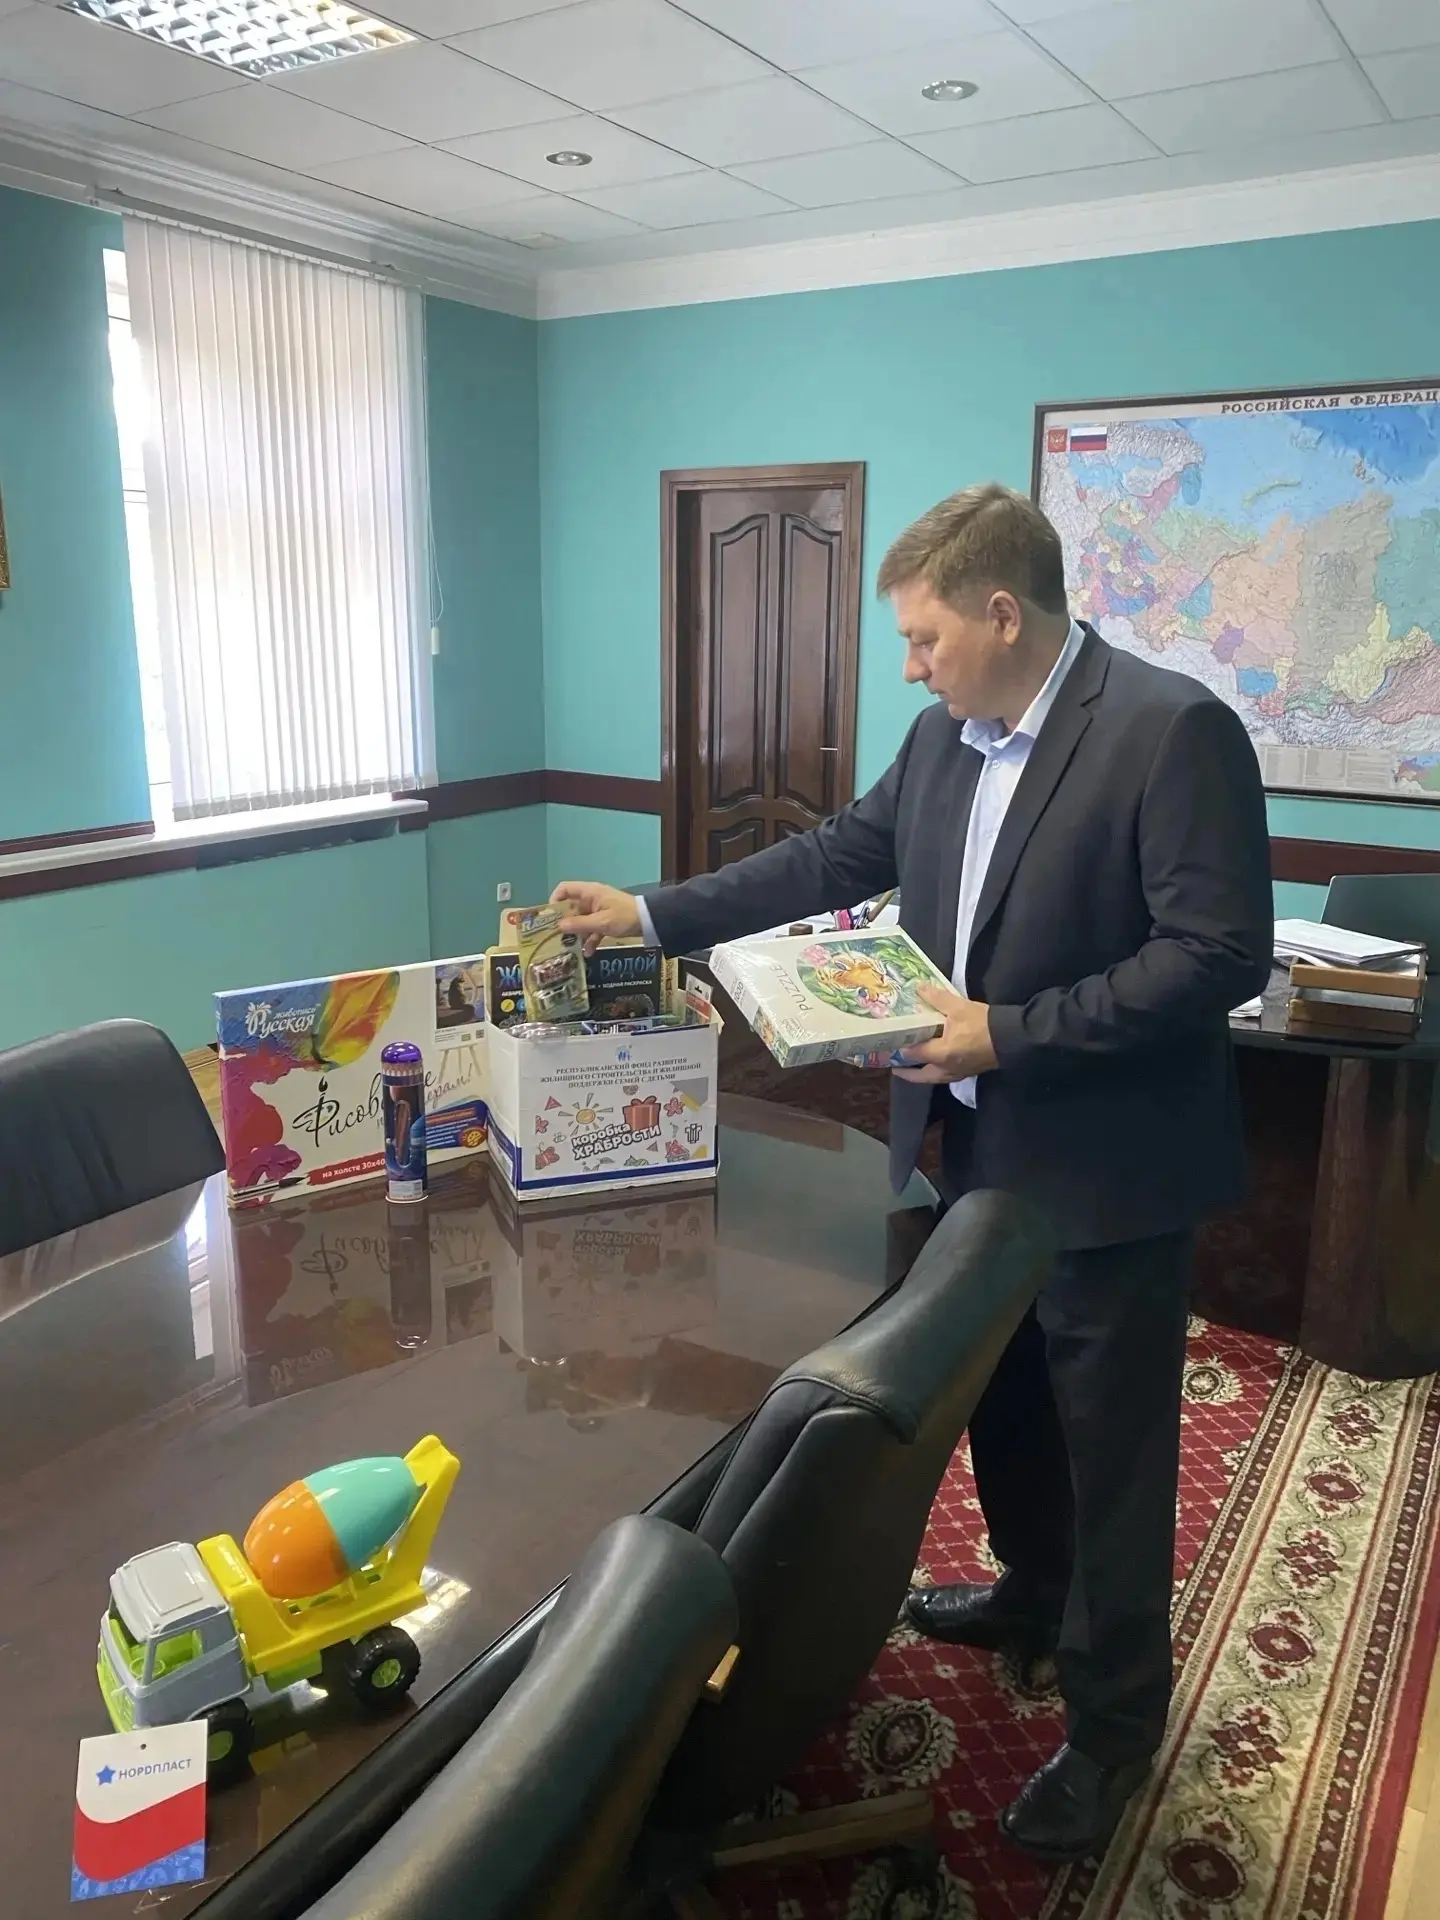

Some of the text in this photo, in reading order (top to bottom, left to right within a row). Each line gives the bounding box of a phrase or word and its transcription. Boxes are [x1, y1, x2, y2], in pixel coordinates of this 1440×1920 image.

[1221, 397, 1341, 414] РОССИЙСКАЯ
[600, 953, 656, 980] ВОДОЙ
[771, 964, 814, 1012] PUZZLE
[246, 1003, 315, 1039] Русская
[540, 1073, 591, 1083] ЖИЛИЩНОГО
[591, 1069, 651, 1080] СТРОИТЕЛЬСТВА
[659, 1063, 701, 1074] ЖИЛИЩНОЙ
[556, 1057, 688, 1074] РЕСПУБЛИКАНСКИЙ ФОНД РАЗВИТИЯ
[568, 1079, 613, 1089] ПОДДЕРЖКИ
[614, 1076, 640, 1085] СЕМЕЙ
[647, 1073, 676, 1083] ДЕТЬМИ
[571, 1122, 632, 1149] коробка
[573, 1124, 662, 1161] ХРАБРОСТИ
[322, 1170, 333, 1179] на
[333, 1163, 361, 1177] холсте
